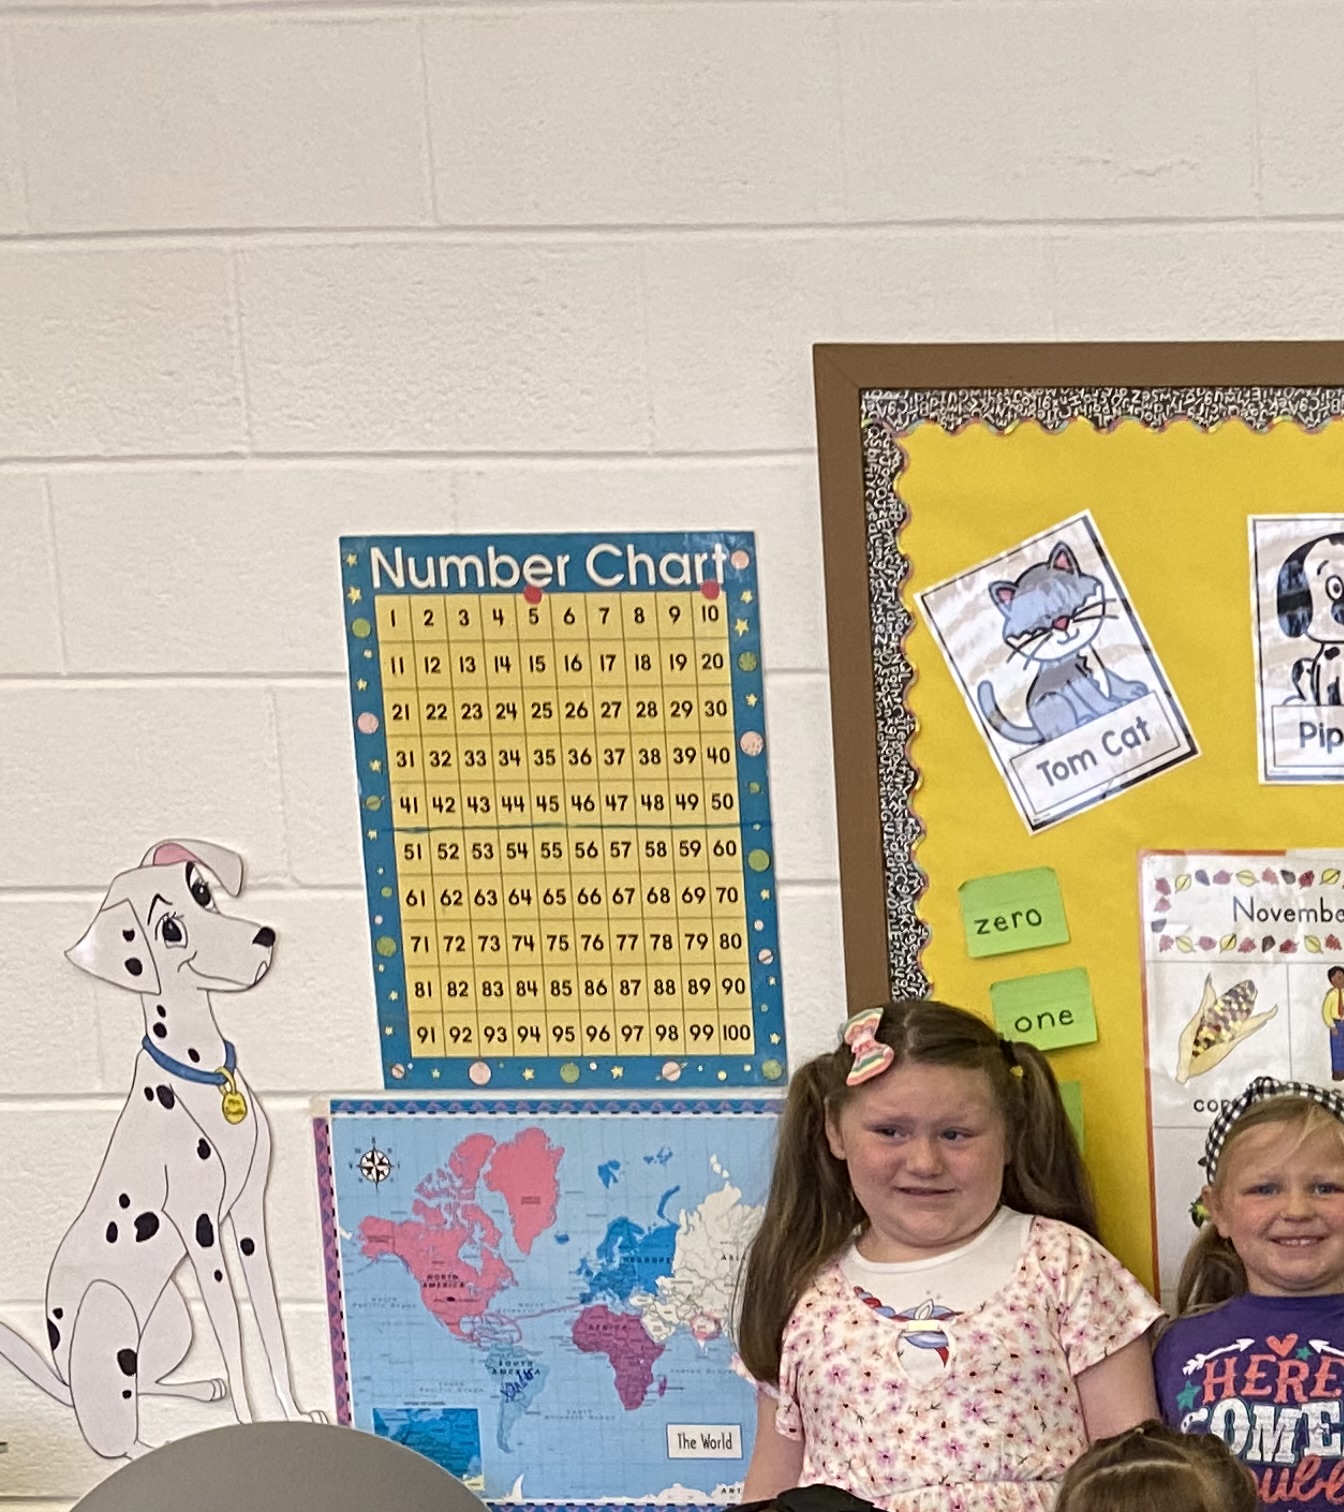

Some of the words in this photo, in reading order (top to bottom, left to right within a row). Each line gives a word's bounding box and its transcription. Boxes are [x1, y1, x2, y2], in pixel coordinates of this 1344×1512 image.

[370, 544, 570, 589] Number
[586, 543, 727, 587] Chart
[390, 610, 396, 627] 1
[424, 609, 434, 626] 2
[458, 609, 469, 626] 3
[493, 609, 504, 626] 4
[529, 608, 539, 624] 5
[564, 608, 575, 624] 6
[599, 607, 610, 624] 7
[634, 607, 645, 624] 8
[669, 606, 680, 623] 9
[702, 605, 719, 622] 10
[391, 657, 404, 674] 11
[424, 656, 440, 674] 12
[460, 656, 476, 673] 13
[494, 656, 511, 673] 14
[529, 655, 546, 672] 15
[564, 655, 582, 672] 16
[600, 654, 616, 672] 17
[635, 654, 651, 671] 18
[670, 654, 687, 671] 19
[702, 653, 724, 669] 20
[392, 704, 409, 720] 21
[426, 704, 447, 720] 22
[462, 703, 483, 720] 23
[496, 703, 517, 719] 24
[531, 702, 552, 718] 25
[565, 702, 588, 718] 26
[601, 702, 622, 718] 27
[636, 701, 658, 718] 28
[671, 700, 693, 717] 29
[705, 700, 727, 717] 30
[1300, 721, 1344, 754] Pip
[396, 751, 414, 768] 31
[429, 750, 451, 767] 32
[464, 750, 486, 766] 33
[499, 750, 520, 766] 34
[534, 749, 556, 766] 35
[568, 748, 592, 765] 36
[604, 748, 625, 765] 37
[638, 748, 661, 765] 38
[673, 747, 696, 764] 39
[707, 747, 730, 764] 40
[1036, 748, 1098, 786] Tom
[1102, 716, 1150, 756] Cat
[404, 843, 422, 860] 51
[438, 843, 459, 860] 52
[472, 843, 494, 860] 53
[506, 842, 528, 859] 54
[541, 842, 562, 858] 55
[575, 841, 598, 858] 56
[610, 842, 631, 858] 57
[646, 841, 667, 858] 58
[680, 840, 701, 857] 59
[713, 840, 736, 857] 60
[974, 908, 1042, 934] zero
[411, 936, 429, 952] 71
[444, 936, 465, 952] 72
[478, 936, 500, 952] 73
[512, 935, 534, 952] 74
[546, 935, 569, 951] 75
[581, 934, 604, 951] 76
[616, 934, 638, 951] 77
[650, 934, 672, 950] 78
[684, 933, 708, 950] 79
[720, 933, 742, 950] 80
[1015, 1010, 1074, 1032] one
[417, 1027, 435, 1043] 91
[449, 1026, 472, 1043] 92
[484, 1026, 507, 1043] 93
[518, 1026, 540, 1042] 94
[552, 1026, 575, 1042] 95
[586, 1025, 610, 1042] 96
[621, 1025, 644, 1042] 97
[656, 1025, 678, 1041] 98
[690, 1024, 714, 1041] 99
[723, 1024, 750, 1040] 100
[678, 1432, 696, 1450] The
[701, 1432, 732, 1450] World
